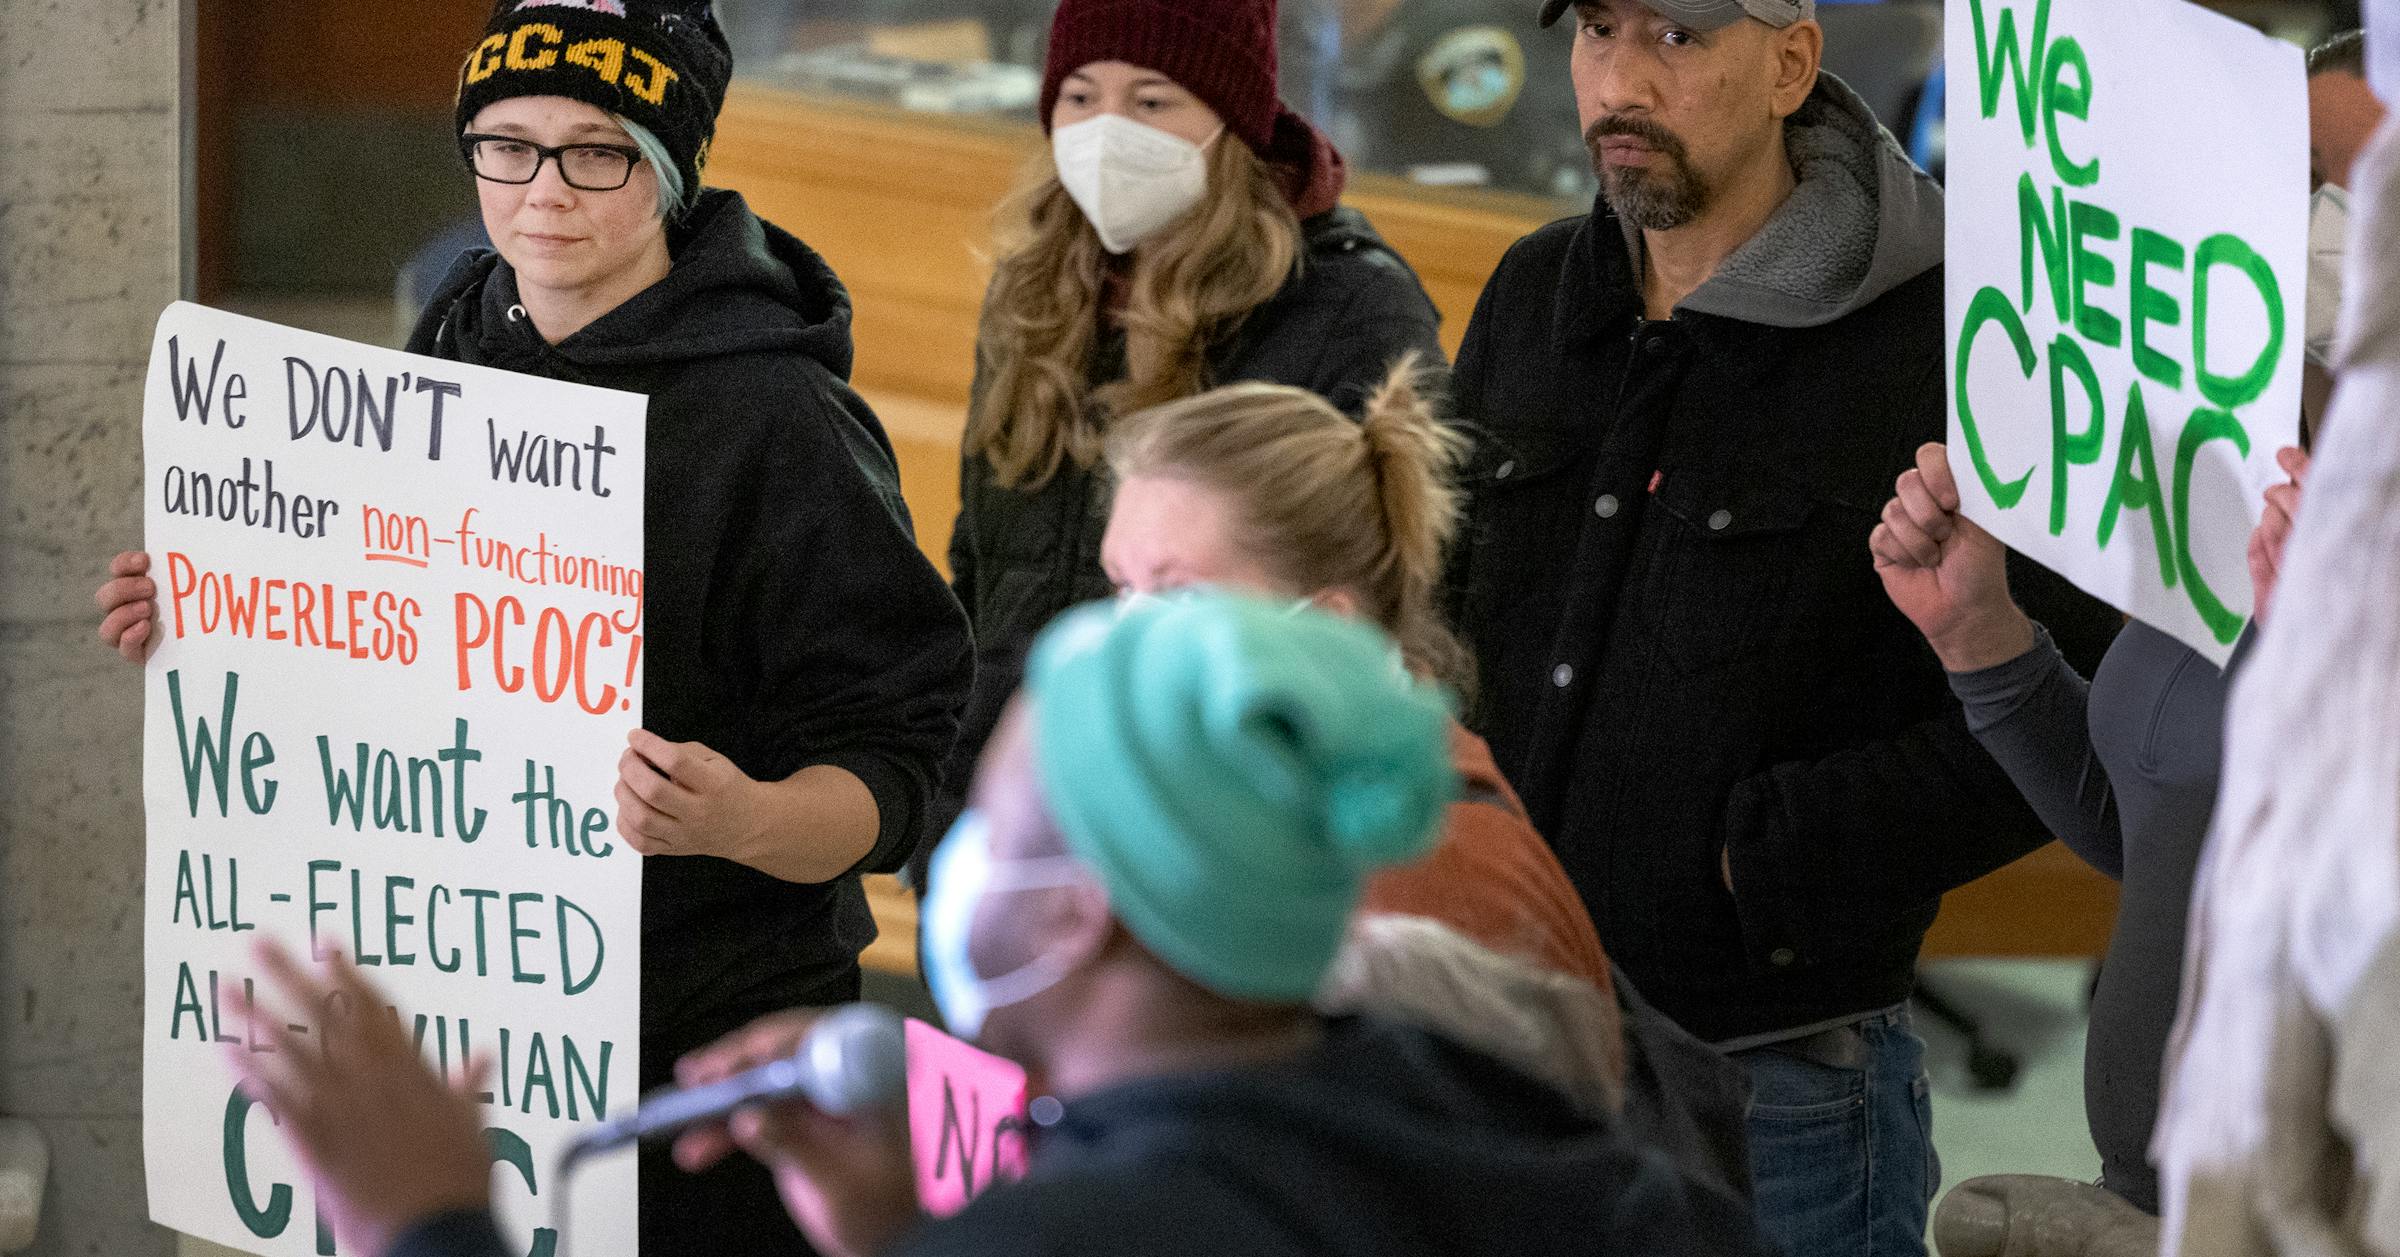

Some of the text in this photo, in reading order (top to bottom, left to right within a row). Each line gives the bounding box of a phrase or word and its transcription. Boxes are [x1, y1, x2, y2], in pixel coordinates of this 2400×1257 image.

[1970, 0, 2100, 187] We
[2018, 171, 2285, 410] NEED
[164, 457, 339, 538] another
[168, 335, 616, 498] We DON'T want
[1956, 286, 2250, 645] CPAC
[167, 552, 643, 715] POWERLESS PCOC!
[167, 669, 613, 858] We want the
